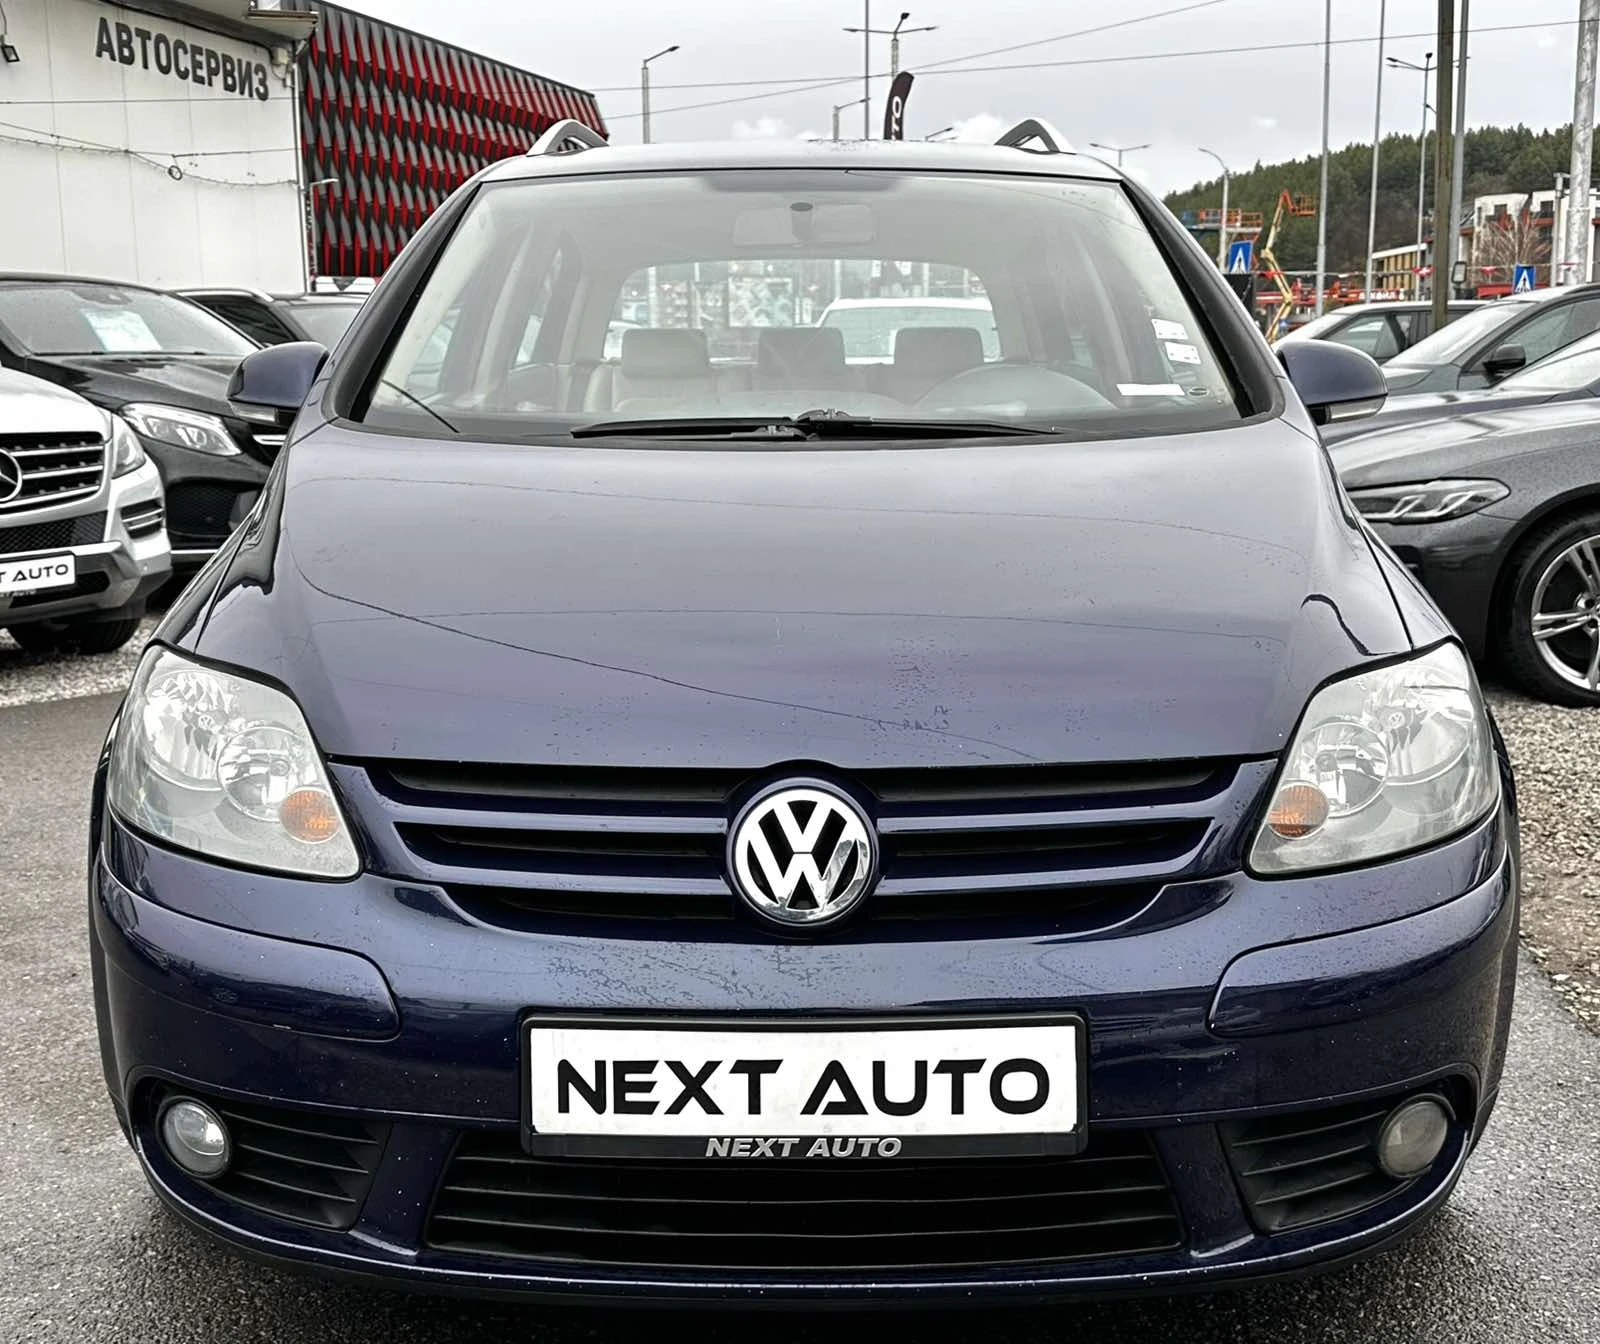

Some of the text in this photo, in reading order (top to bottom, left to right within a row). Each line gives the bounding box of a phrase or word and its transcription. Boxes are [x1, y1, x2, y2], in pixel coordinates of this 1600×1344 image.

[95, 17, 269, 101] АВТОСЕРВИЗ
[891, 96, 902, 140] TO
[12, 564, 69, 582] AUTO
[557, 1058, 1050, 1117] NEXT AUTO
[705, 1137, 902, 1157] NEXT AUTO
